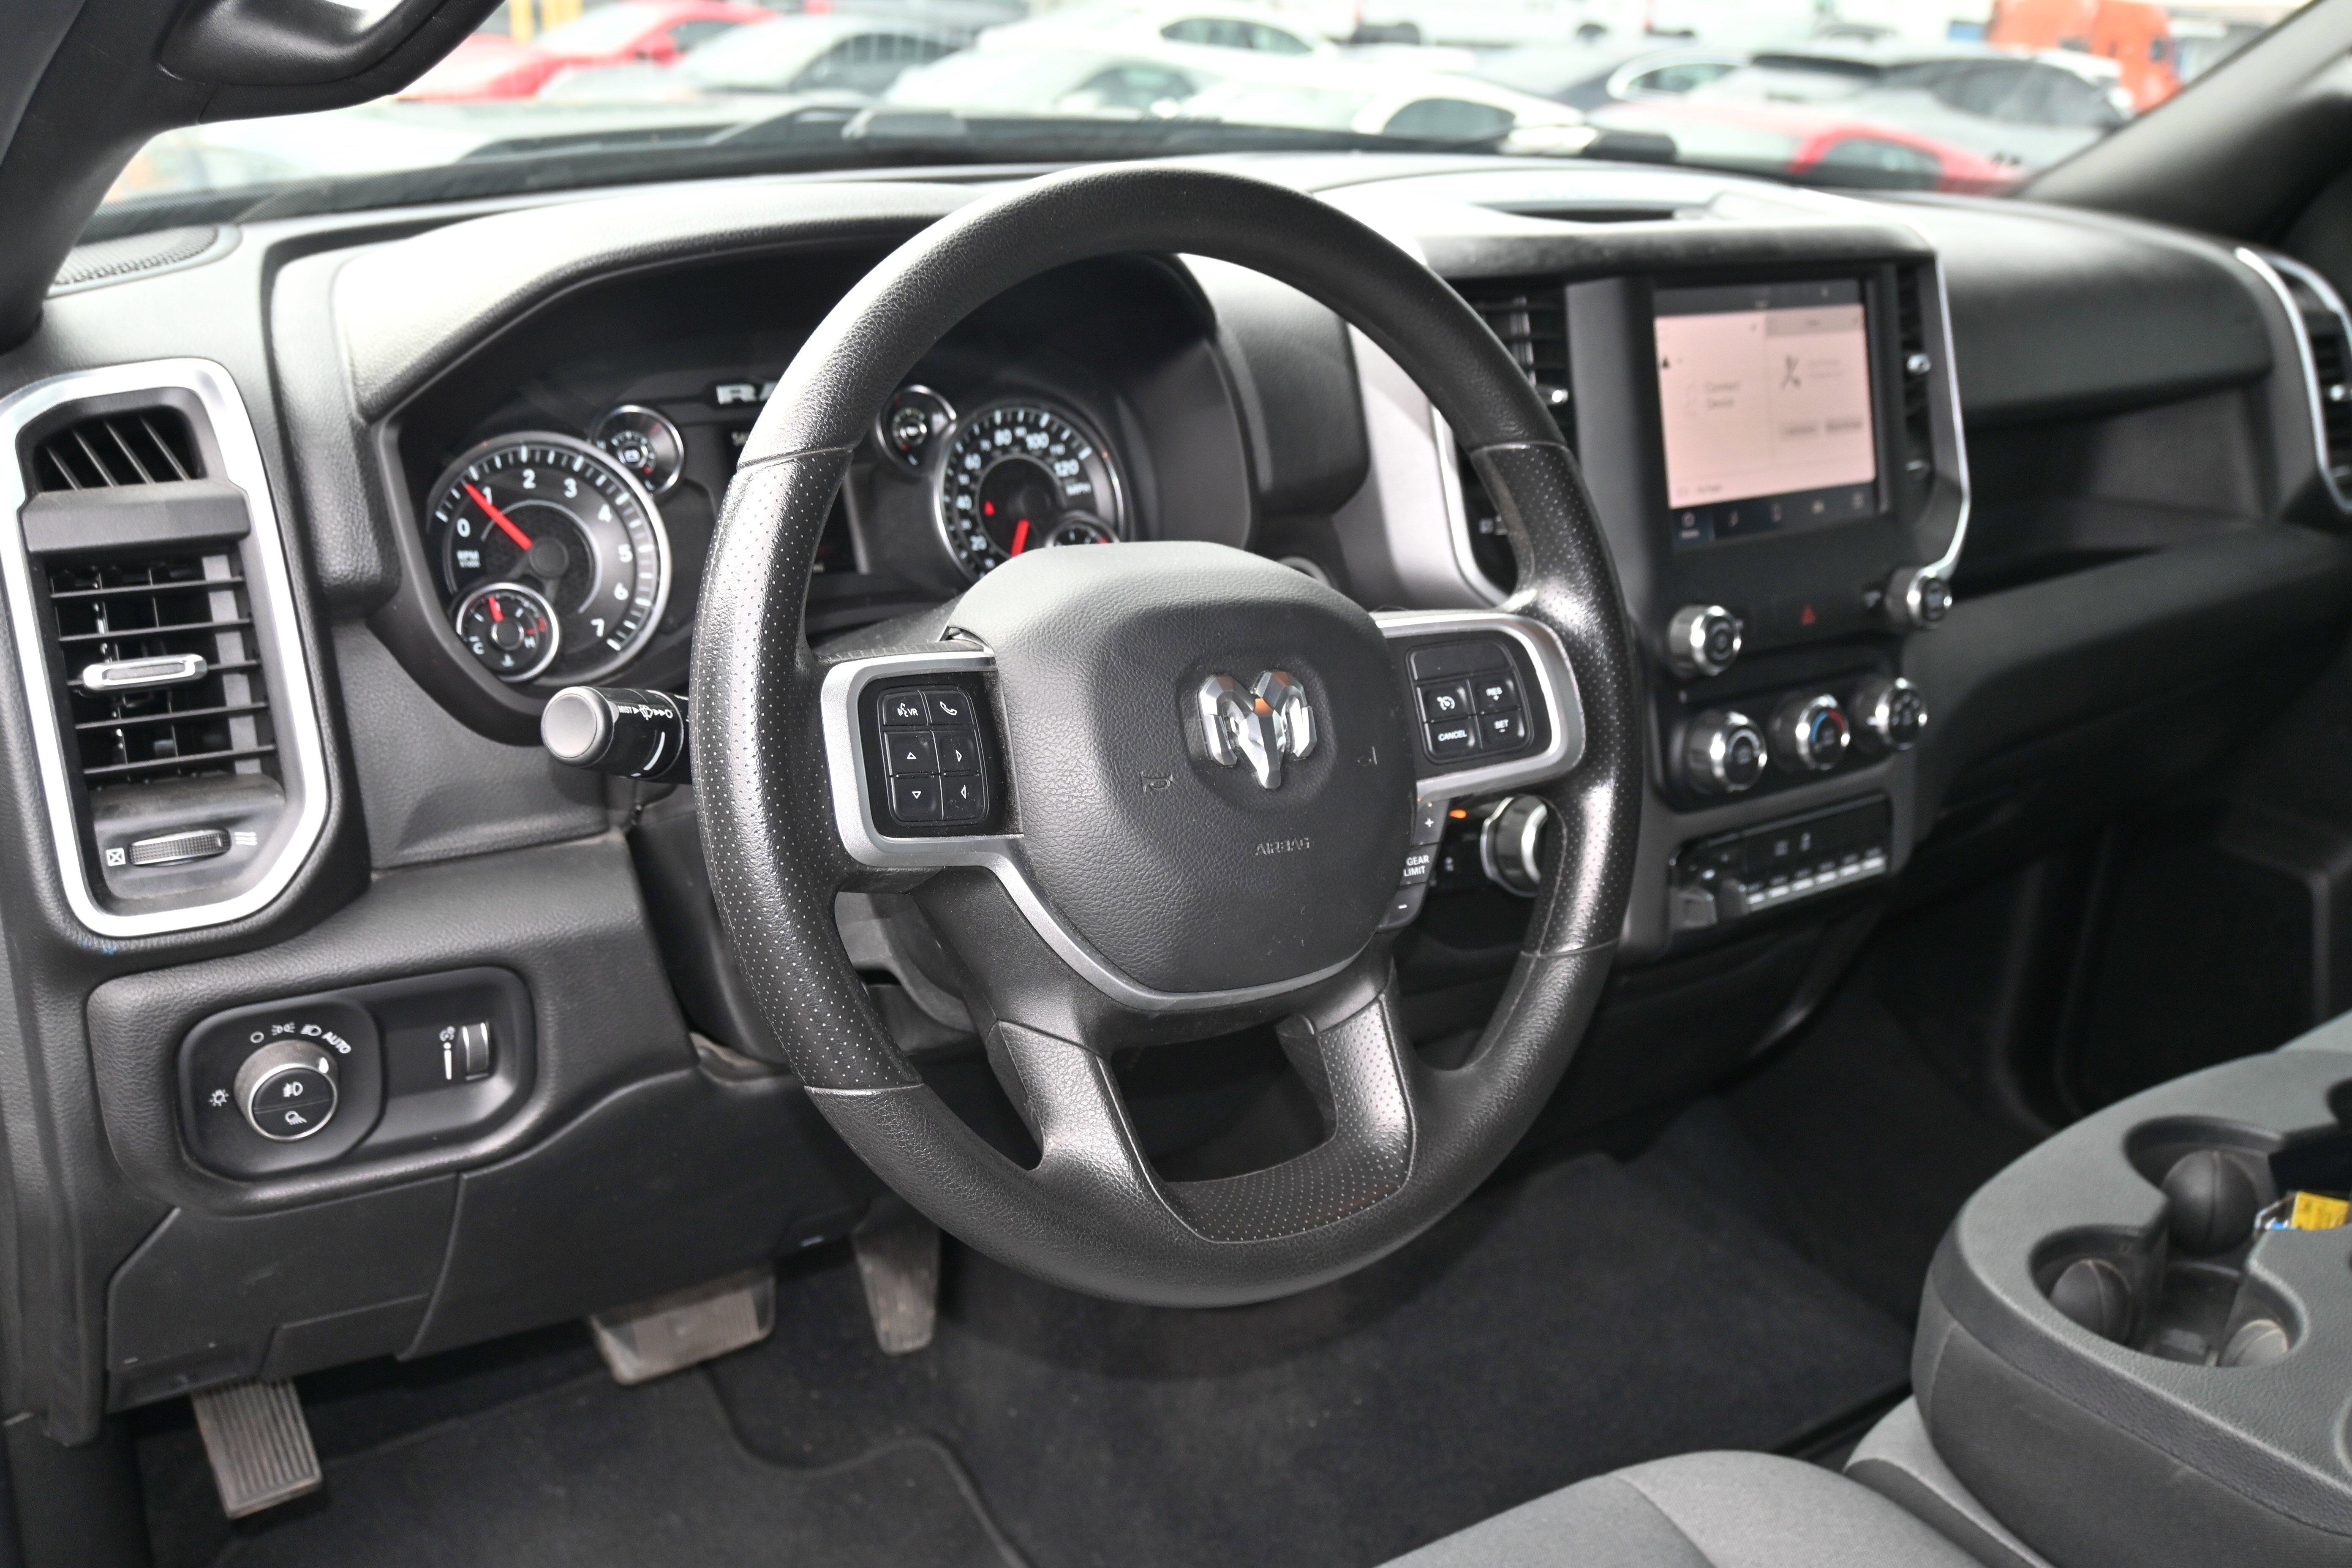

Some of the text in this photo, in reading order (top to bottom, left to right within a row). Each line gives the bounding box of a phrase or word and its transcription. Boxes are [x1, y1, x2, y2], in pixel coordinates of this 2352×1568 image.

[994, 428, 1013, 446] 80
[1025, 431, 1049, 450] 100
[964, 453, 982, 471] 60
[1054, 458, 1079, 477] 120
[523, 469, 536, 489] 2
[564, 478, 577, 498] 3
[482, 486, 492, 504] 1
[956, 494, 972, 510] 40
[598, 504, 612, 522] 4
[457, 518, 471, 537] 0
[969, 535, 987, 551] 20
[457, 550, 479, 560] RPM
[618, 544, 634, 563] 5
[613, 582, 629, 601] 6
[591, 618, 605, 637] 7
[473, 642, 485, 655] C
[524, 636, 536, 648] H
[1486, 686, 1503, 696] RES
[618, 705, 632, 714] MIST
[907, 708, 918, 716] VR
[1494, 719, 1509, 729] SET
[1437, 730, 1467, 742] CANCEL
[1406, 855, 1429, 866] GEAR
[1403, 865, 1426, 877] LIMIT
[322, 1032, 351, 1054] AUTO
